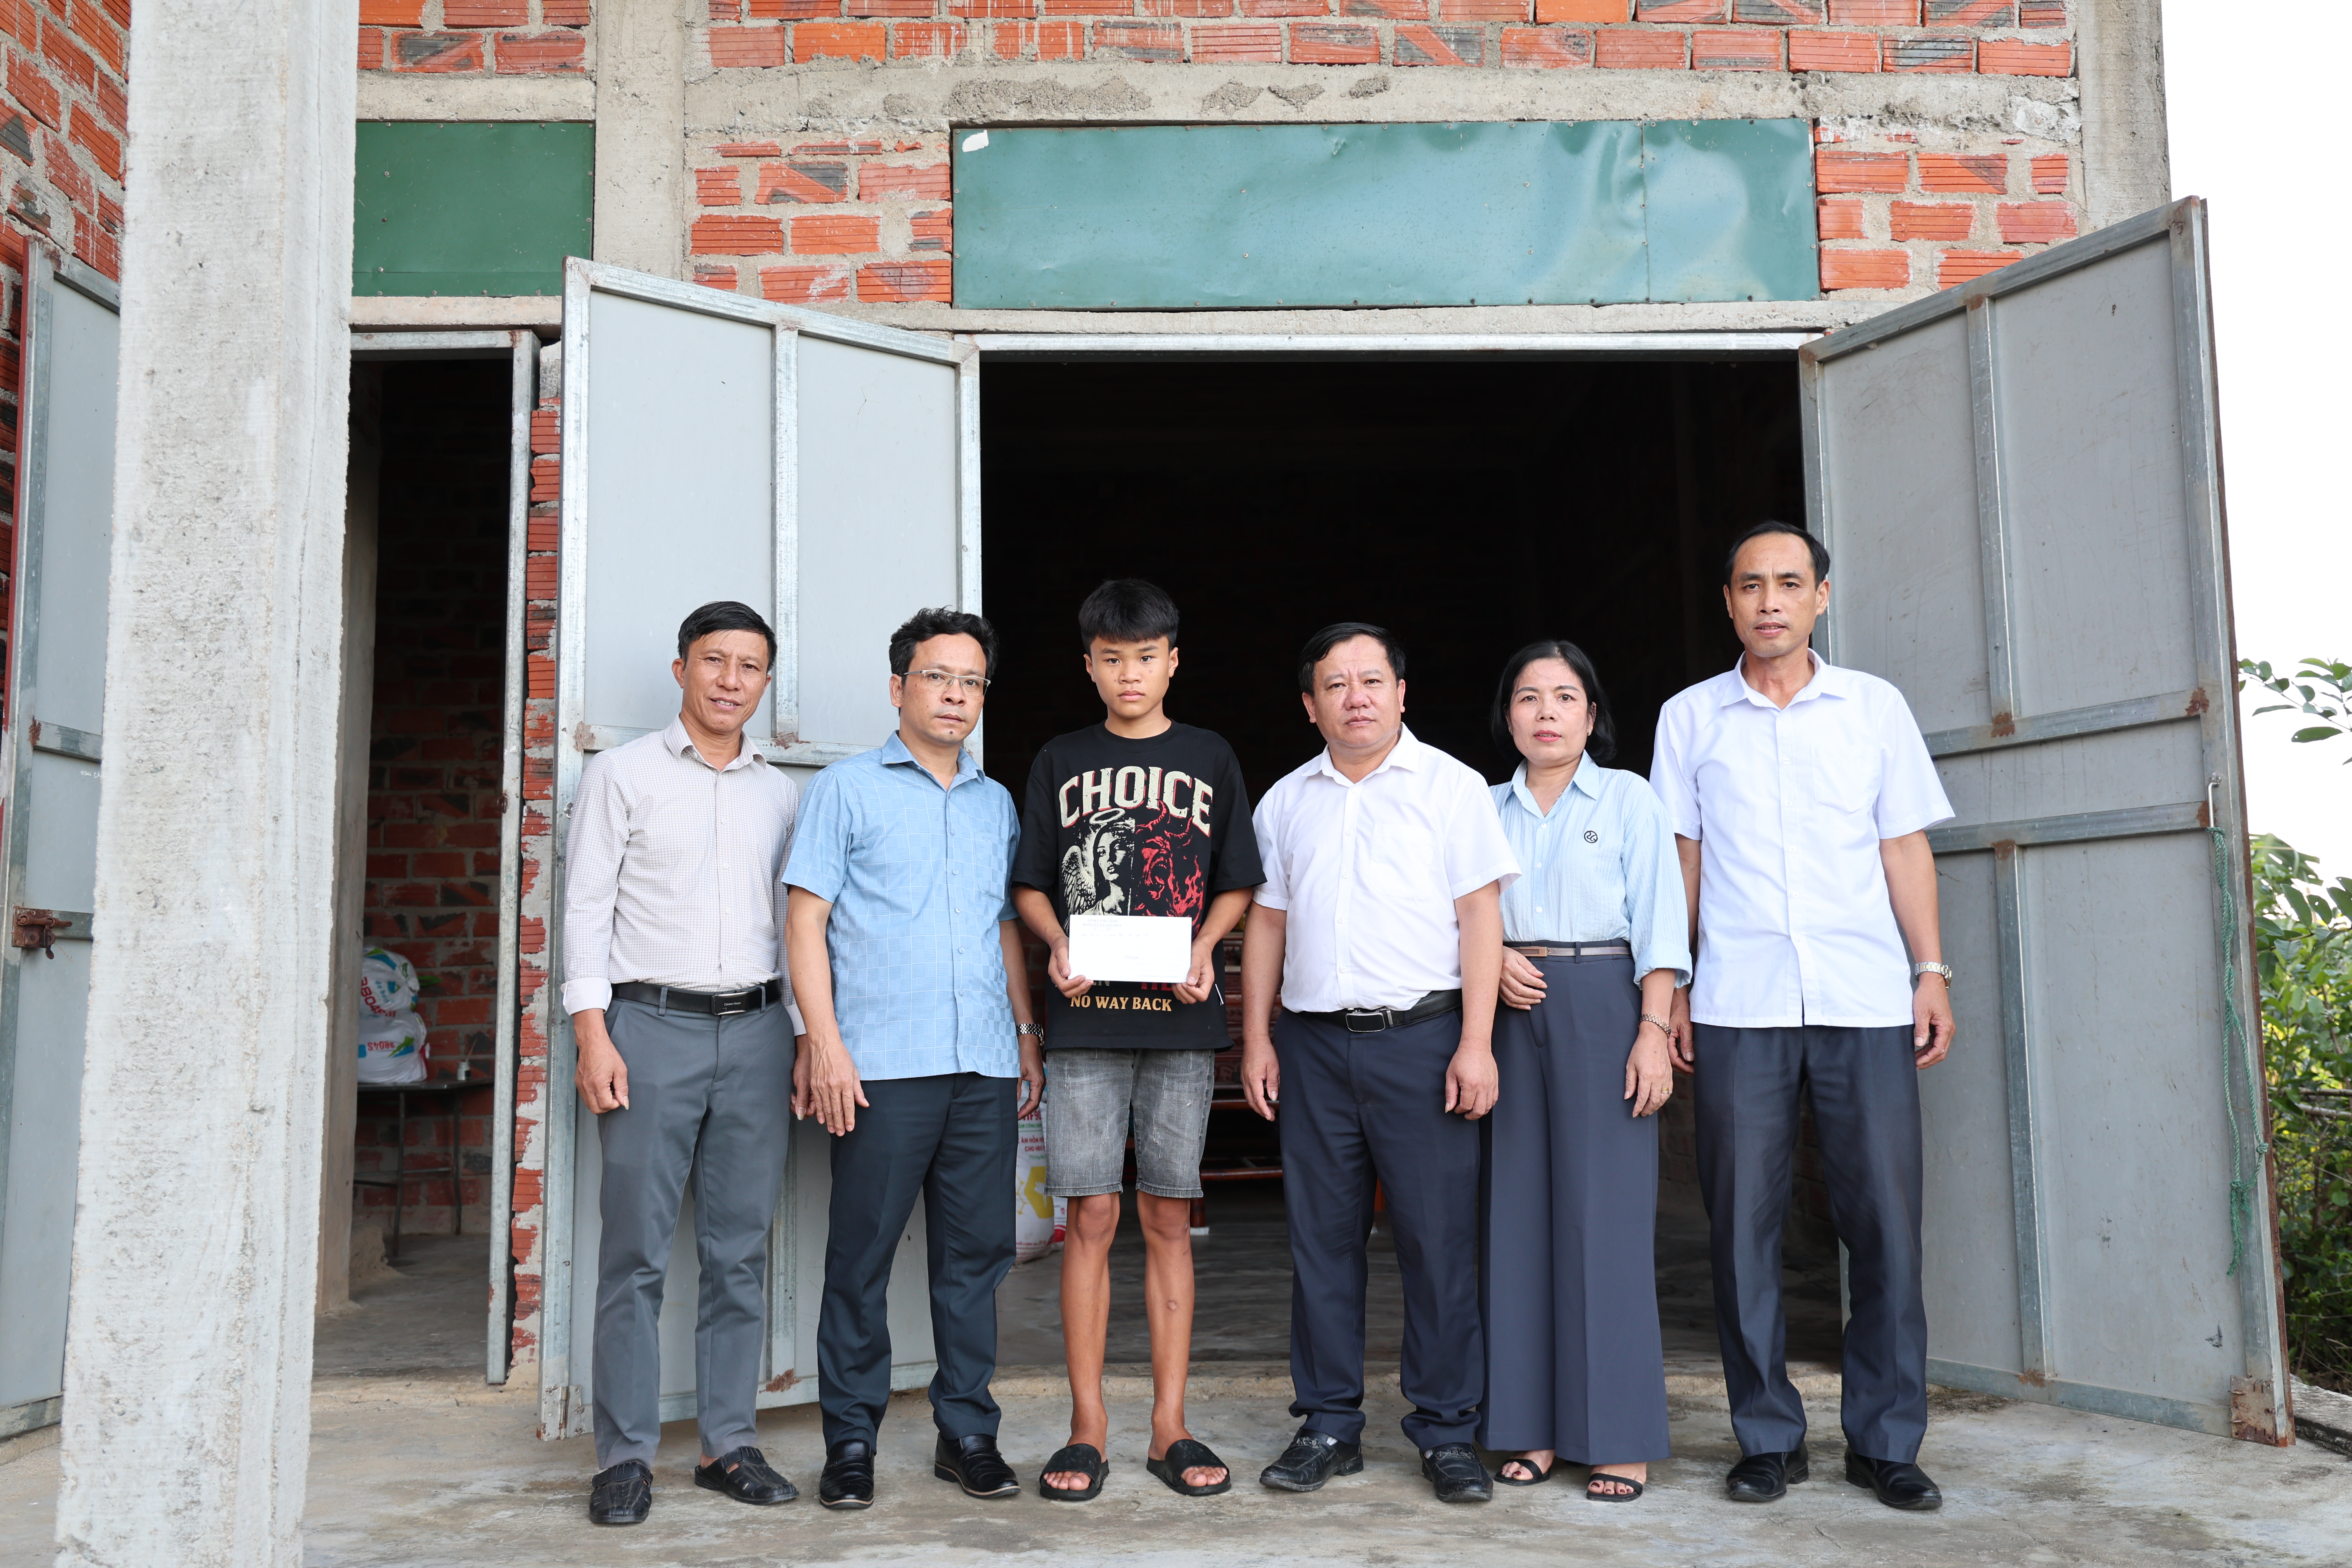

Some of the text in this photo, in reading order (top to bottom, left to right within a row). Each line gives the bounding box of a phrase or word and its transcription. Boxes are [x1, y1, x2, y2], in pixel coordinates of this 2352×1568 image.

[1059, 766, 1213, 837] CHOICE
[1070, 995, 1172, 1011] NO WAY BACK
